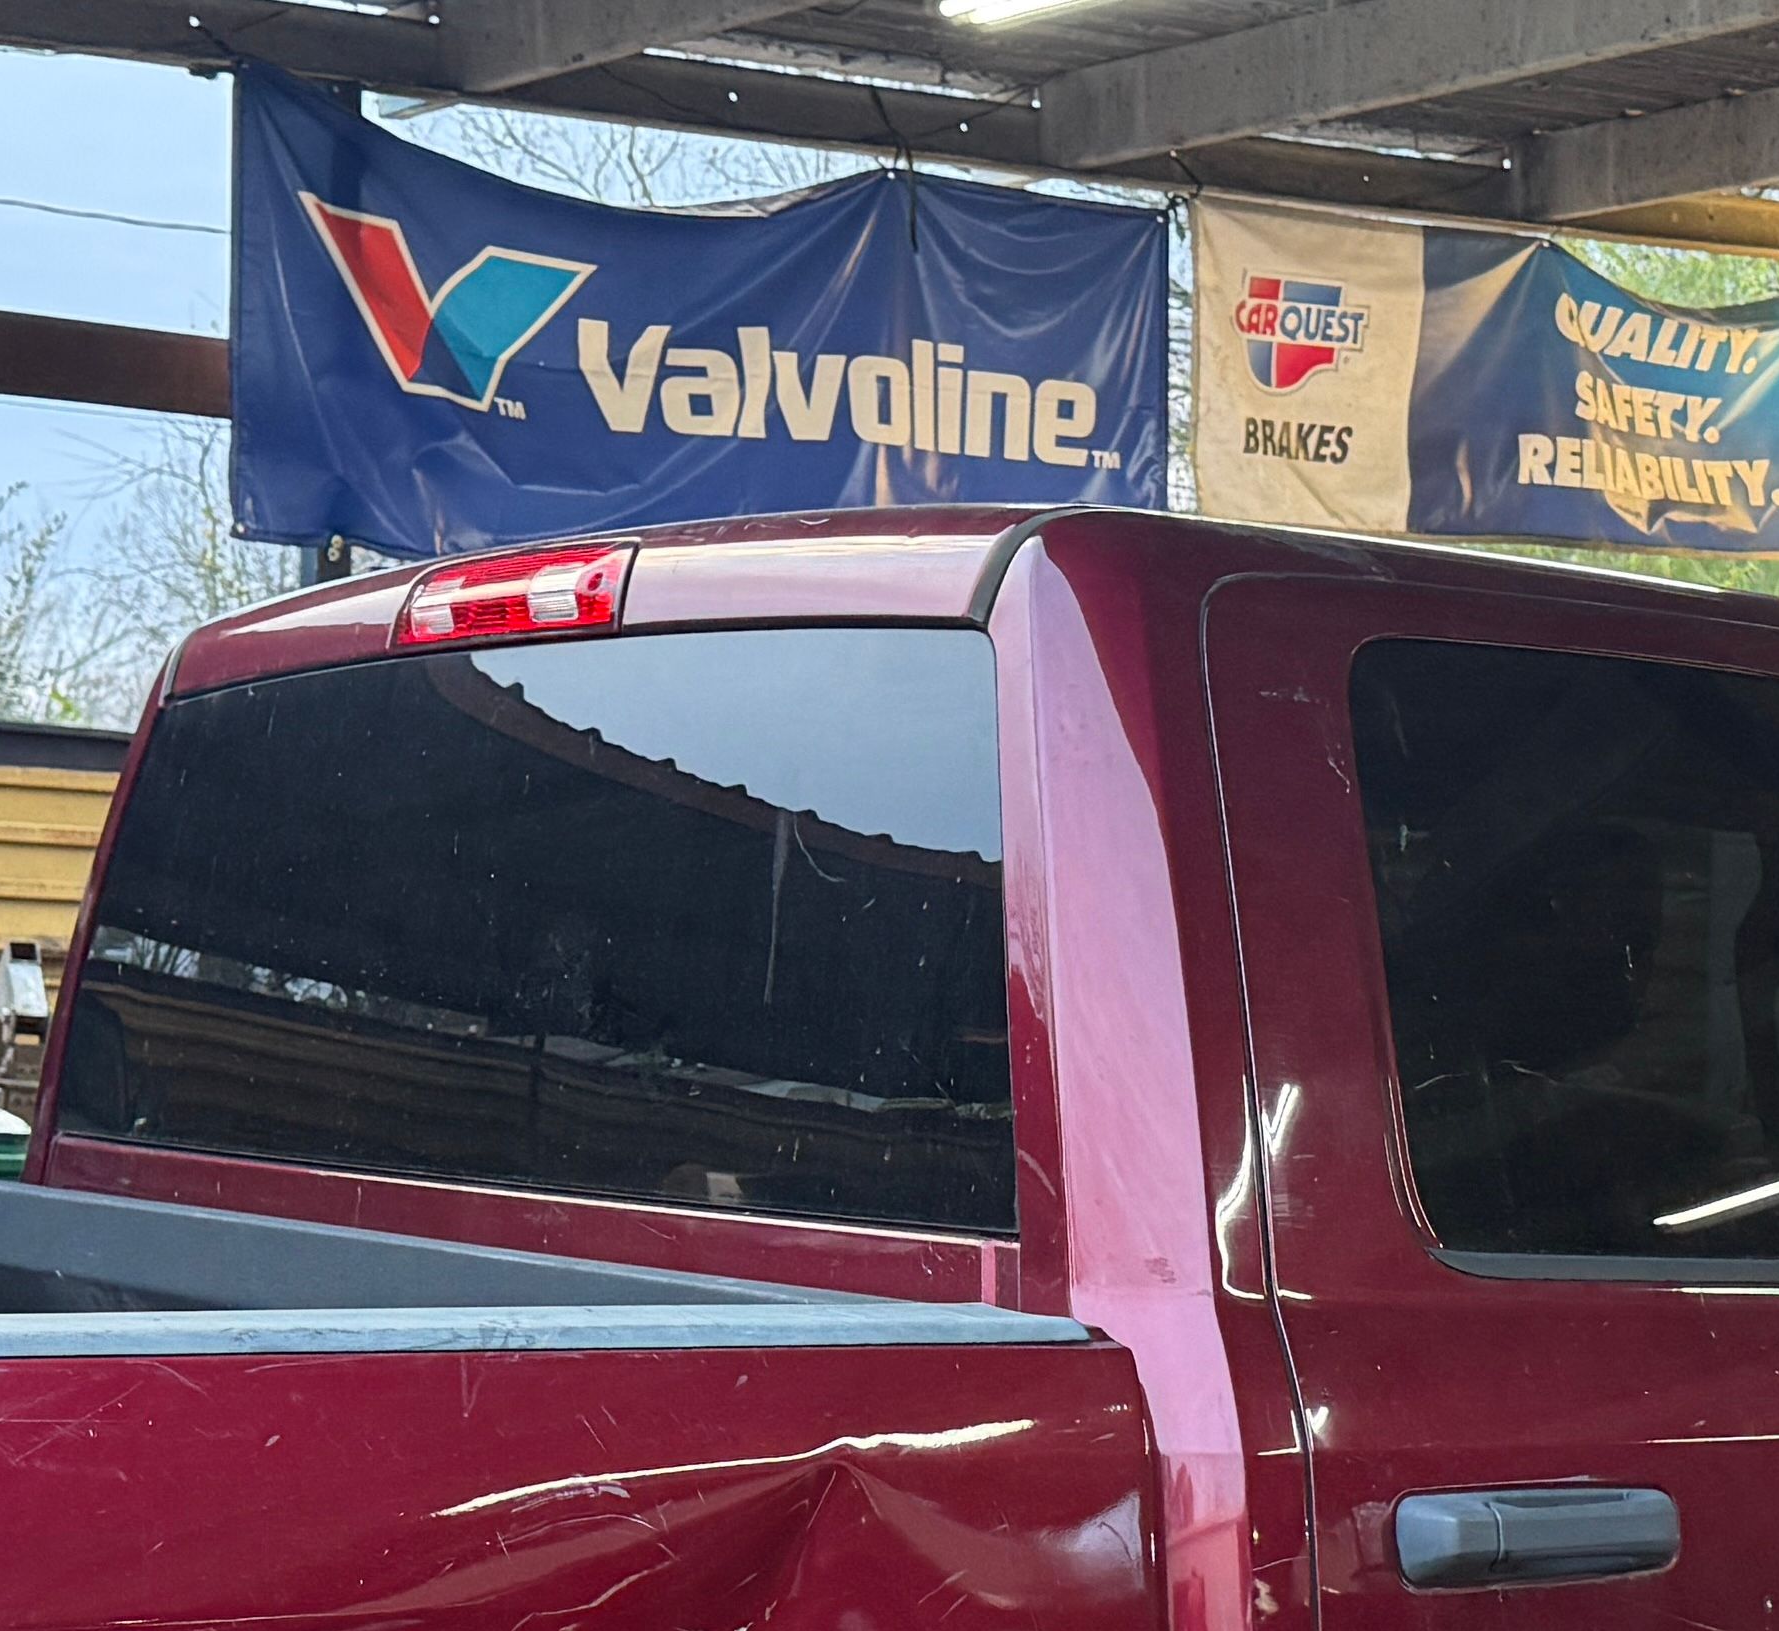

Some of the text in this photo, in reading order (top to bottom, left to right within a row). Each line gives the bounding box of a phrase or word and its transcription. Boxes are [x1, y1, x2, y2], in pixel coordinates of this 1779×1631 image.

[1235, 299, 1365, 344] CARQUEST
[1554, 293, 1757, 375] QUALITY.
[578, 317, 1097, 467] Valvoline
[1575, 370, 1722, 445] SAFETY.
[1243, 416, 1353, 465] BRAKES
